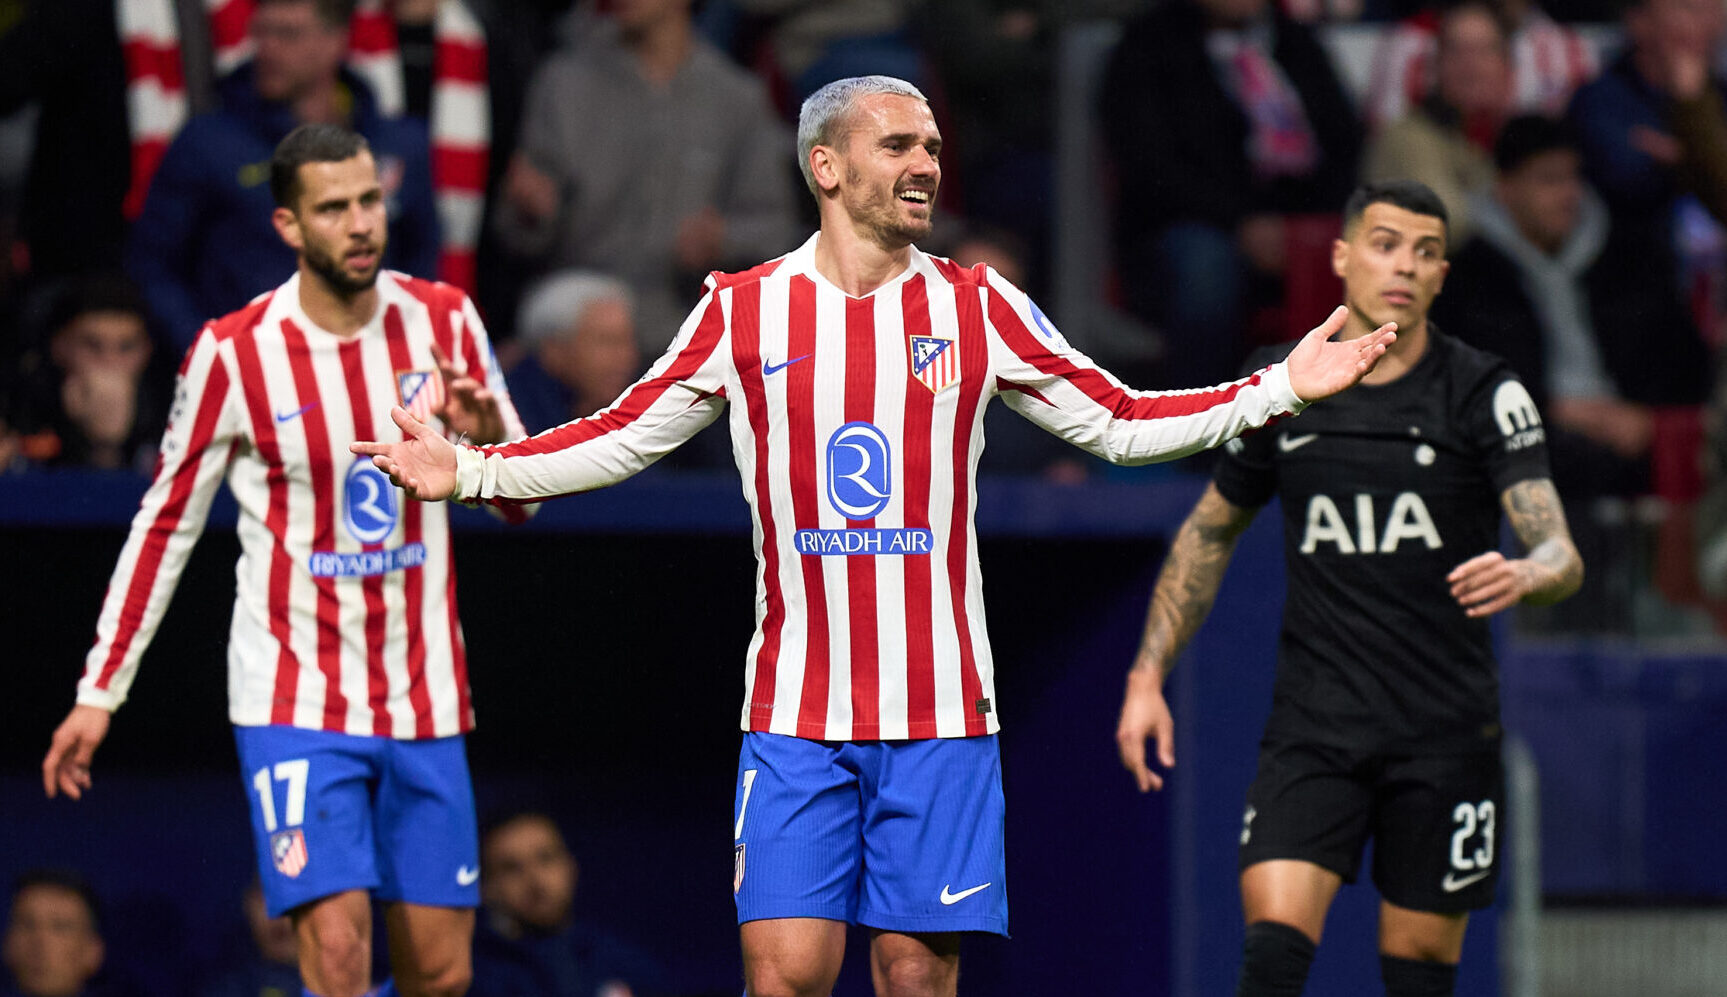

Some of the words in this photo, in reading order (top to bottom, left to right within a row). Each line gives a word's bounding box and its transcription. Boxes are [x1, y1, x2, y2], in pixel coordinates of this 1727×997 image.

[800, 531, 881, 552] RIYADH
[889, 531, 928, 552] AIR
[1299, 491, 1443, 554] AIA
[312, 550, 393, 576] RIYADH
[253, 758, 309, 832] 17
[1451, 799, 1496, 870] 23
